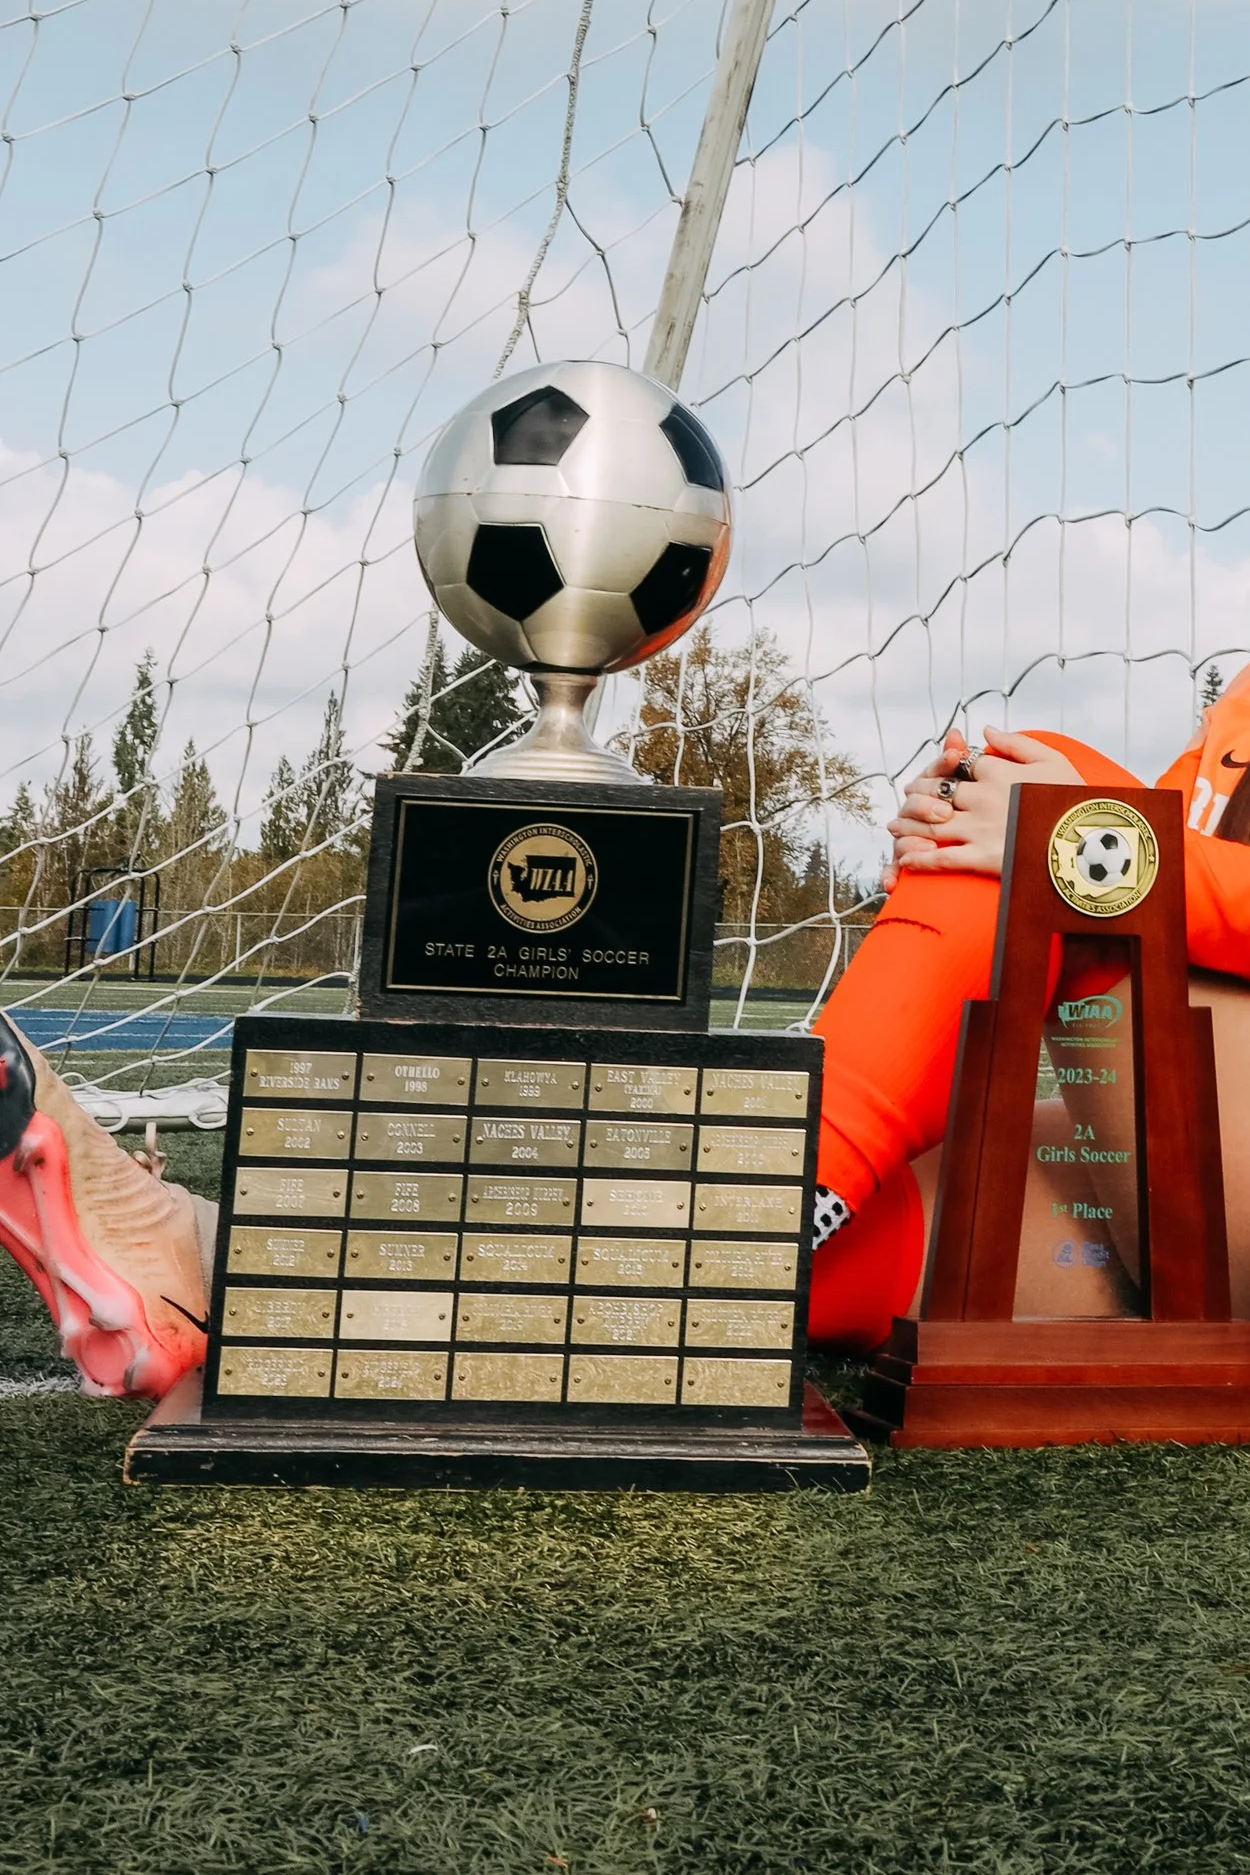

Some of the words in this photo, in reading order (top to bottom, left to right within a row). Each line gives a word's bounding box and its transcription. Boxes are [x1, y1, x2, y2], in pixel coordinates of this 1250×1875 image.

[496, 827, 538, 863] WASHINGTON
[539, 827, 593, 867] INTERSCHOLASTIC
[500, 904, 535, 929] ACTIVITIES
[536, 906, 582, 930] ASSOCIATION
[425, 942, 475, 958] STATE
[487, 945, 508, 959] 2A
[519, 947, 572, 962] GIRLS'
[582, 948, 650, 965] SOCCER
[494, 963, 579, 980] CHAMPION
[1069, 1004, 1113, 1019] WIAA
[289, 1062, 313, 1074] 1997
[394, 1065, 440, 1079] OTHELLO
[1057, 1068, 1116, 1084] 2023-24
[259, 1075, 310, 1090] RIVERSIDE
[607, 1069, 637, 1084] EAST
[640, 1070, 682, 1086] VALLEY
[629, 1097, 654, 1109] 2000
[530, 1124, 572, 1141] VALLEY
[605, 1127, 672, 1145] EATONVILLE
[1074, 1124, 1095, 1140] 2A
[284, 1136, 310, 1149] 2002
[511, 1146, 539, 1160] 2004
[1037, 1145, 1076, 1162] Girls
[1080, 1146, 1131, 1163] Soccer
[279, 1178, 304, 1193] FIFE
[393, 1182, 420, 1197] FIFE
[1072, 1202, 1113, 1219] Place
